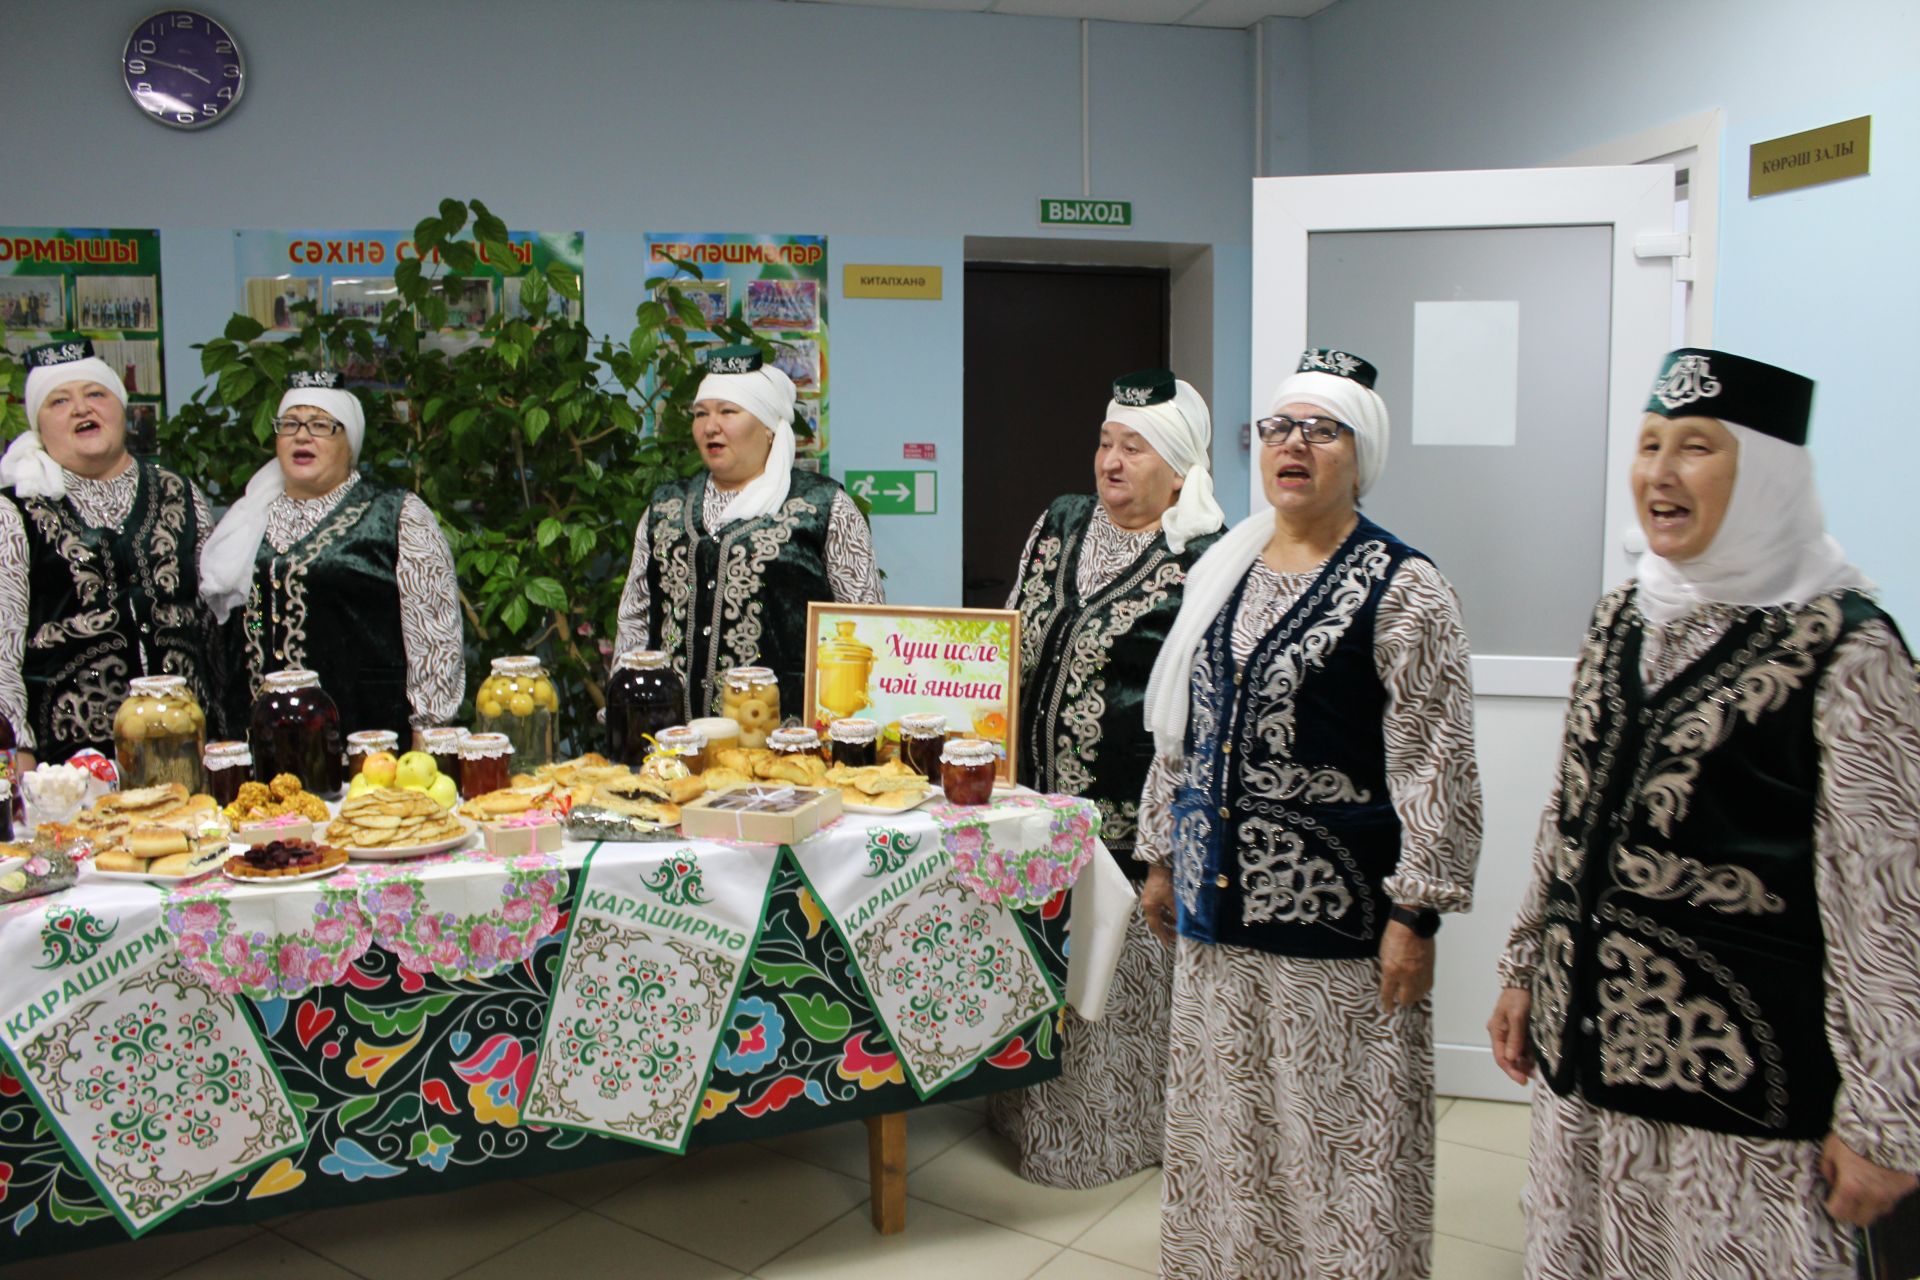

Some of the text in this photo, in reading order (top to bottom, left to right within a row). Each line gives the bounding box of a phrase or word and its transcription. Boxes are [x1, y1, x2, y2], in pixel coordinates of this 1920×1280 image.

[171, 15, 194, 29] 12
[134, 40, 156, 54] 10
[215, 40, 233, 54] 2
[128, 59, 147, 74] 9
[223, 64, 240, 78] 3
[136, 82, 152, 96] 8
[217, 86, 233, 100] 4
[202, 103, 218, 117] 5
[177, 111, 194, 124] 6
[1814, 140, 1855, 163] ЗАЛЫ
[1048, 202, 1124, 223] ВЫХОД
[288, 240, 385, 264] СӘХНӘ
[860, 276, 926, 287] КИТАПХАНӘ
[885, 633, 998, 666] Хуш исле
[879, 672, 1002, 700] чәй янына
[844, 850, 946, 936] КАРАШИР
[584, 889, 747, 951] КАРАШИРМӘ
[5, 926, 169, 1041] КАРАШИРМ
